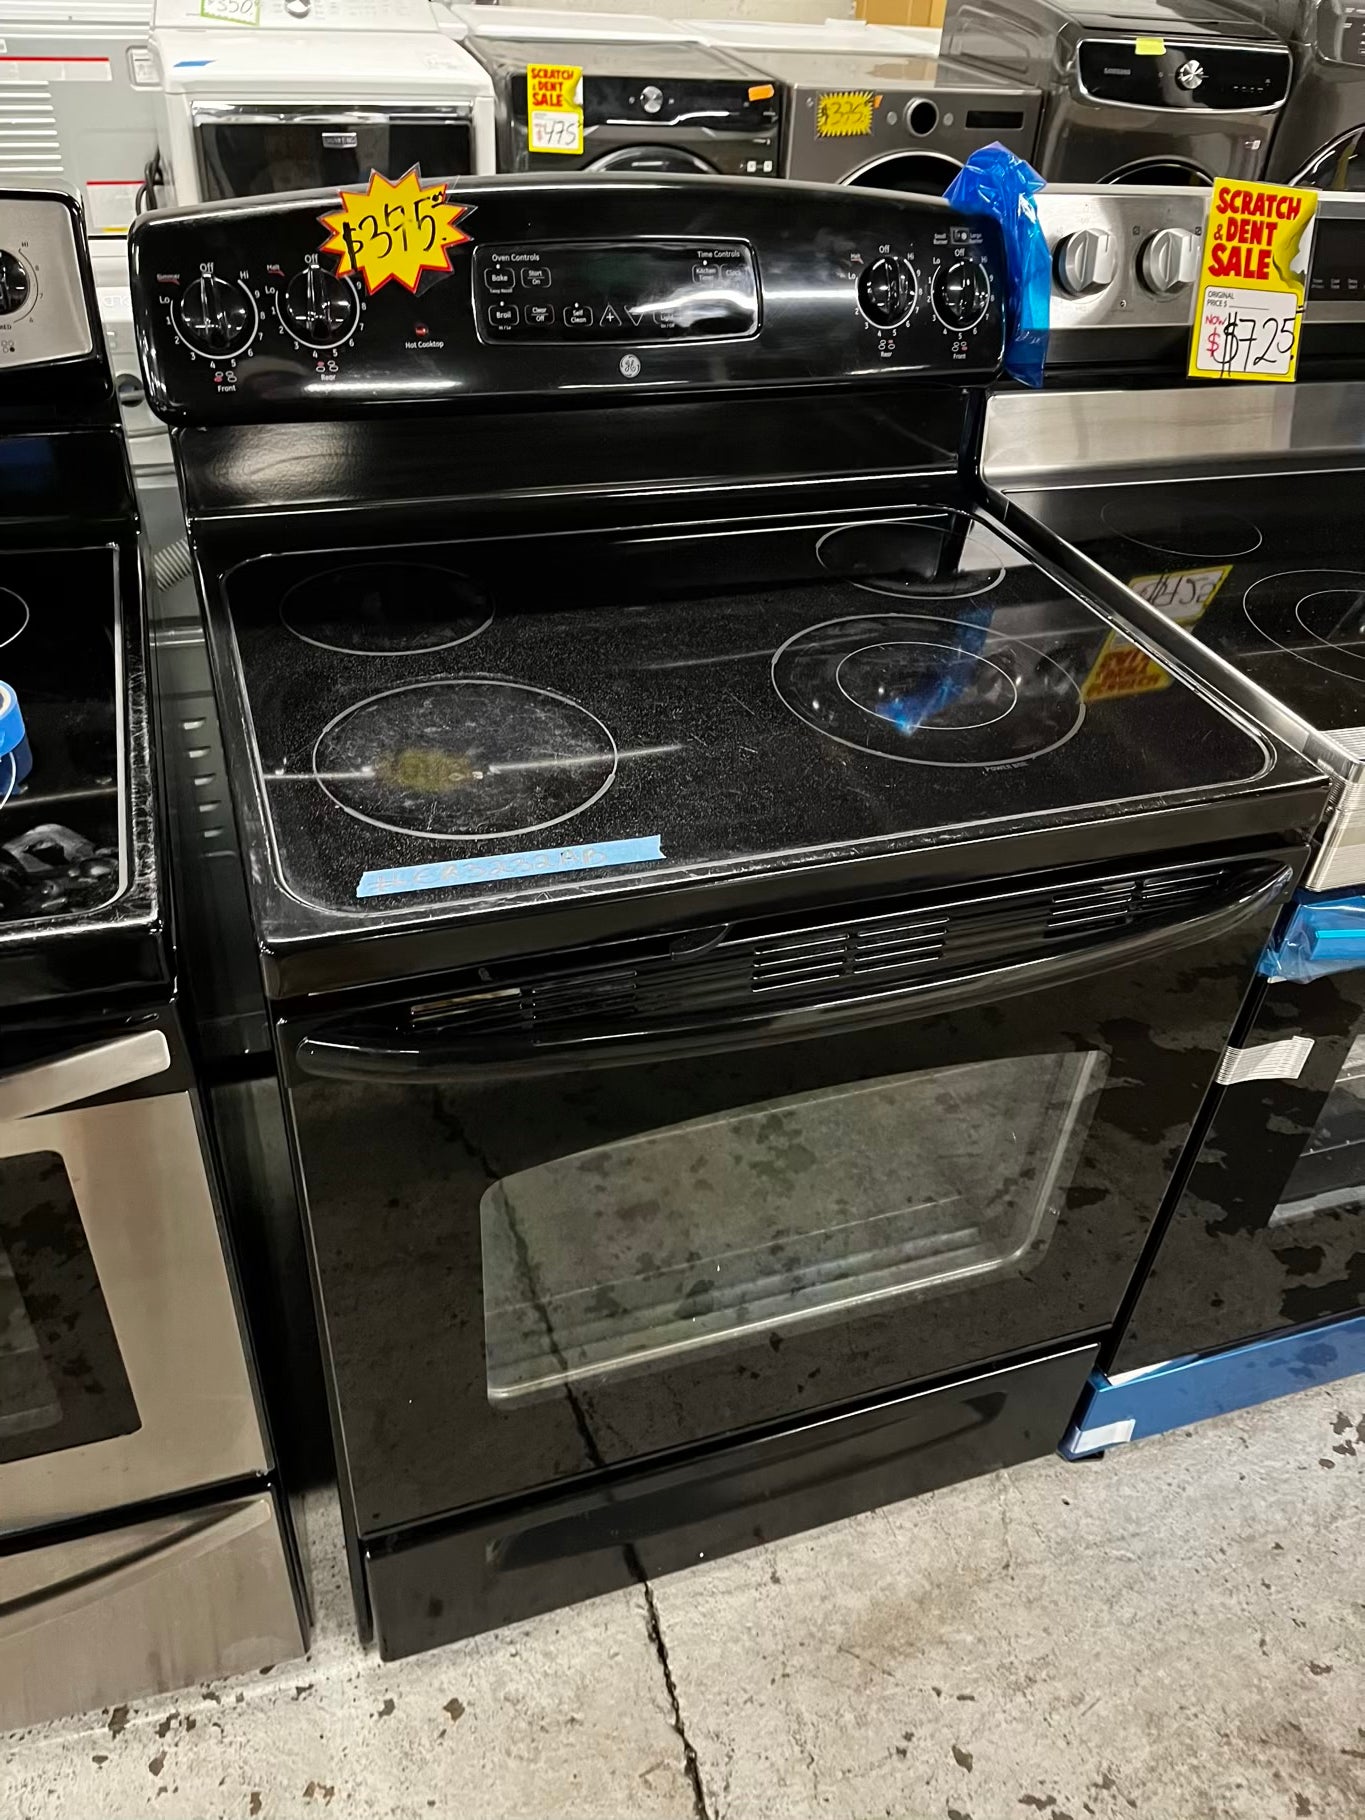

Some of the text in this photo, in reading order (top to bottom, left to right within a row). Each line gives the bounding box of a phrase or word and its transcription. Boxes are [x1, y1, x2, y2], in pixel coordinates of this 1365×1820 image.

[531, 68, 574, 80] SCRATCH
[538, 81, 563, 92] DENT
[532, 93, 563, 107] SALE
[1216, 187, 1302, 220] SCRATCH
[1213, 217, 1277, 246] & DENT
[879, 245, 890, 253] Off
[955, 249, 965, 257] Off
[511, 253, 540, 261] Controls
[714, 250, 740, 258] Controls
[304, 254, 318, 264] Off
[1208, 243, 1271, 280] SALE
[200, 263, 214, 273] Off
[240, 271, 249, 280] Hi
[356, 281, 362, 289] 9
[254, 290, 260, 298] 9
[265, 286, 275, 295] Lo
[1207, 291, 1234, 300] ORIGINAL
[159, 296, 170, 304] Lo
[361, 302, 367, 310] 8
[1205, 315, 1226, 325] NOW
[279, 326, 284, 334] 2
[175, 336, 180, 344] 2
[349, 339, 354, 347] 6
[418, 340, 444, 348] Cooktop
[294, 341, 299, 350] 3
[191, 352, 196, 360] 3
[248, 349, 253, 357] 6
[312, 350, 318, 358] 4
[333, 349, 338, 357] 5
[210, 360, 216, 369] 4
[231, 359, 236, 367] 5
[218, 384, 236, 392] Front
